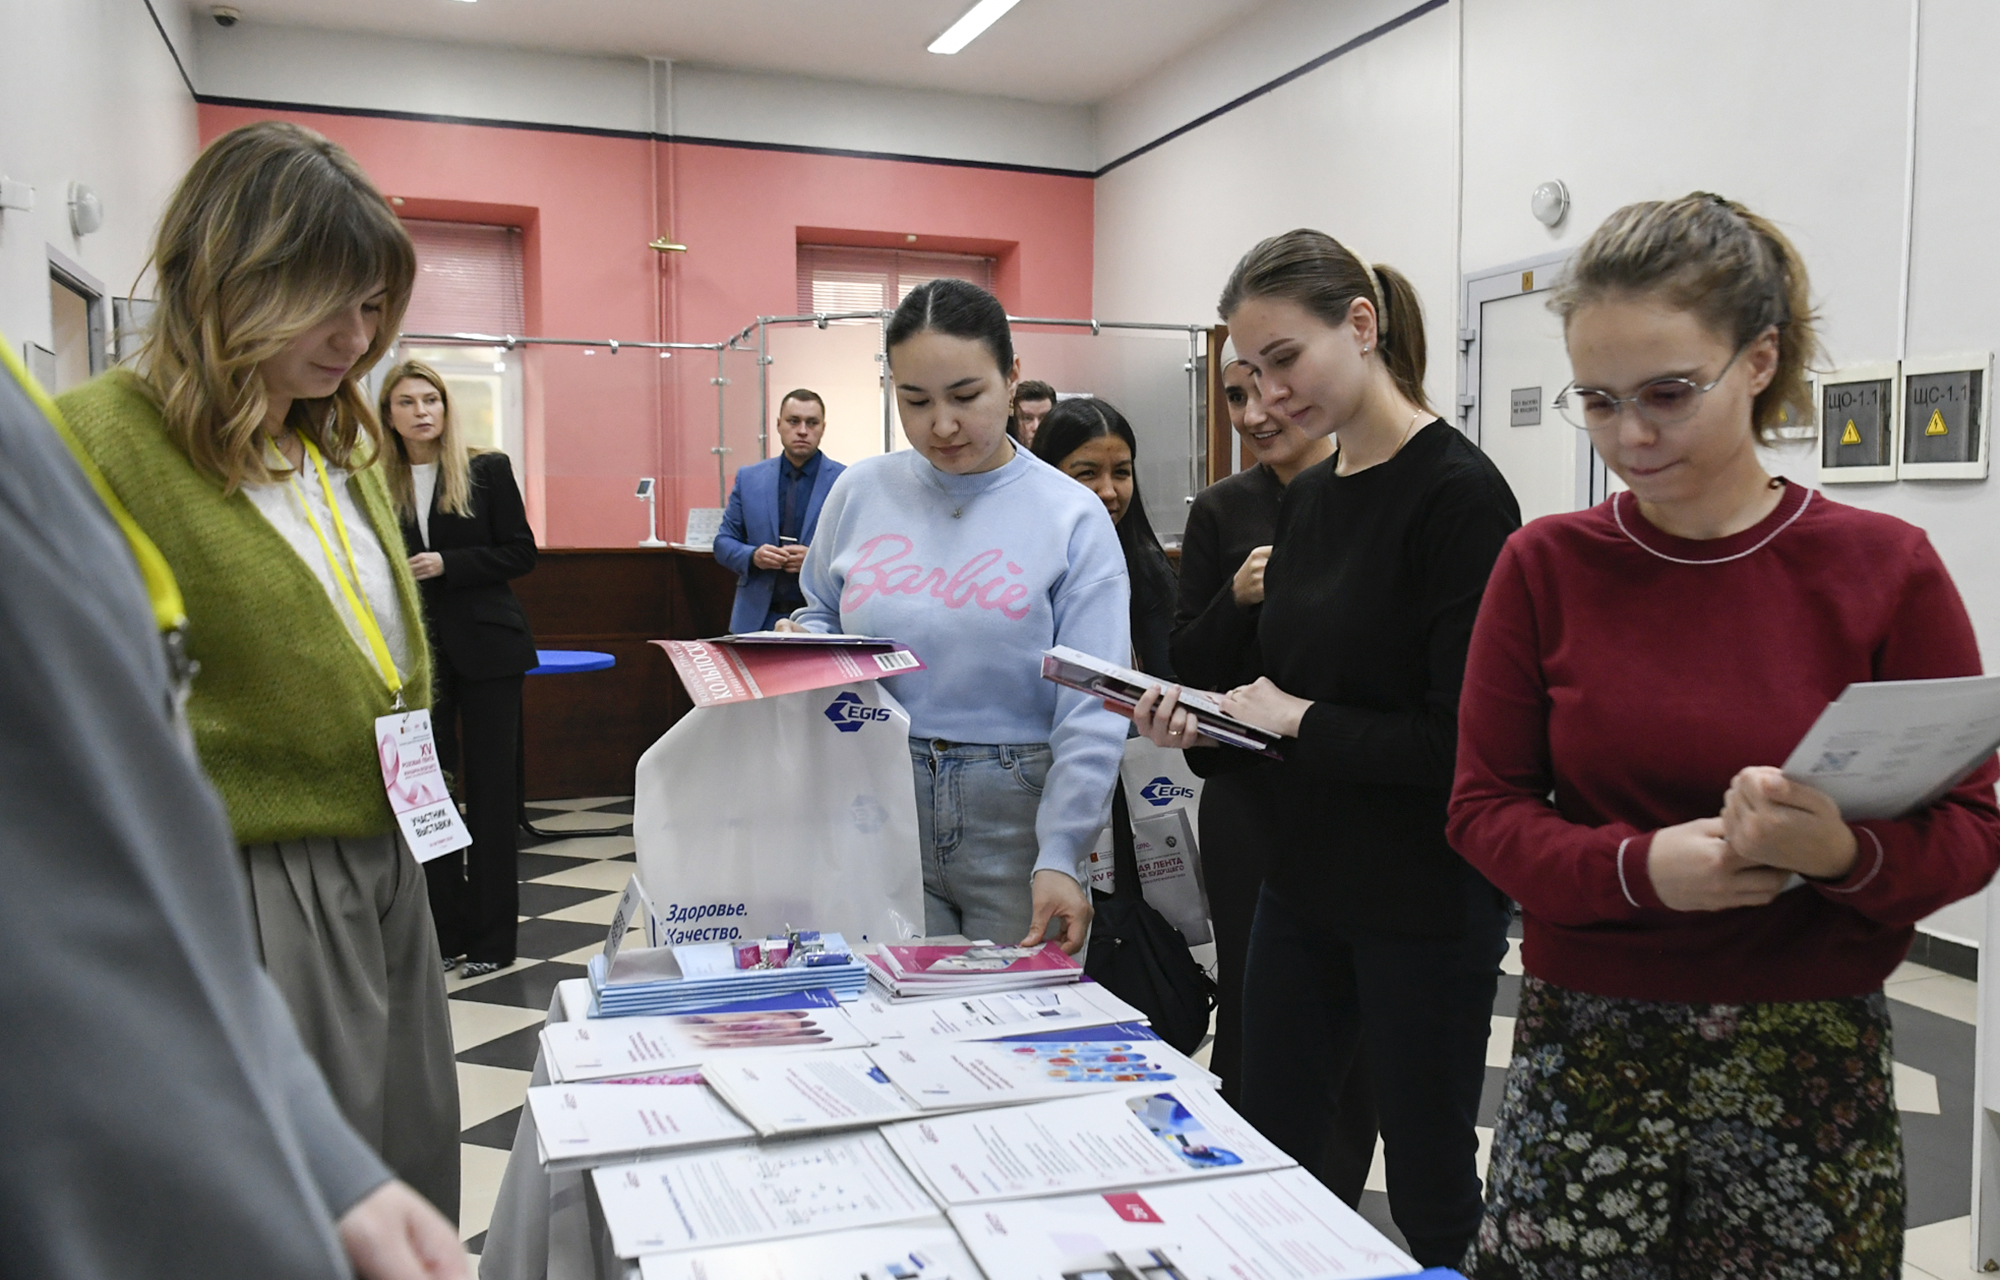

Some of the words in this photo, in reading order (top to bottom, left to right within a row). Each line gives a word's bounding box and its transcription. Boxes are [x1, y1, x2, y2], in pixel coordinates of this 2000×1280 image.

[1828, 389, 1878, 412] ЩО-1.1
[1913, 384, 1968, 408] ЩС-1.1
[841, 533, 1031, 621] Barbie
[847, 705, 892, 722] EGIS
[1158, 786, 1195, 799] EGIS
[1153, 857, 1184, 870] ЛЕНТА
[665, 902, 748, 924] Здоровье.
[664, 925, 743, 946] Качество.
